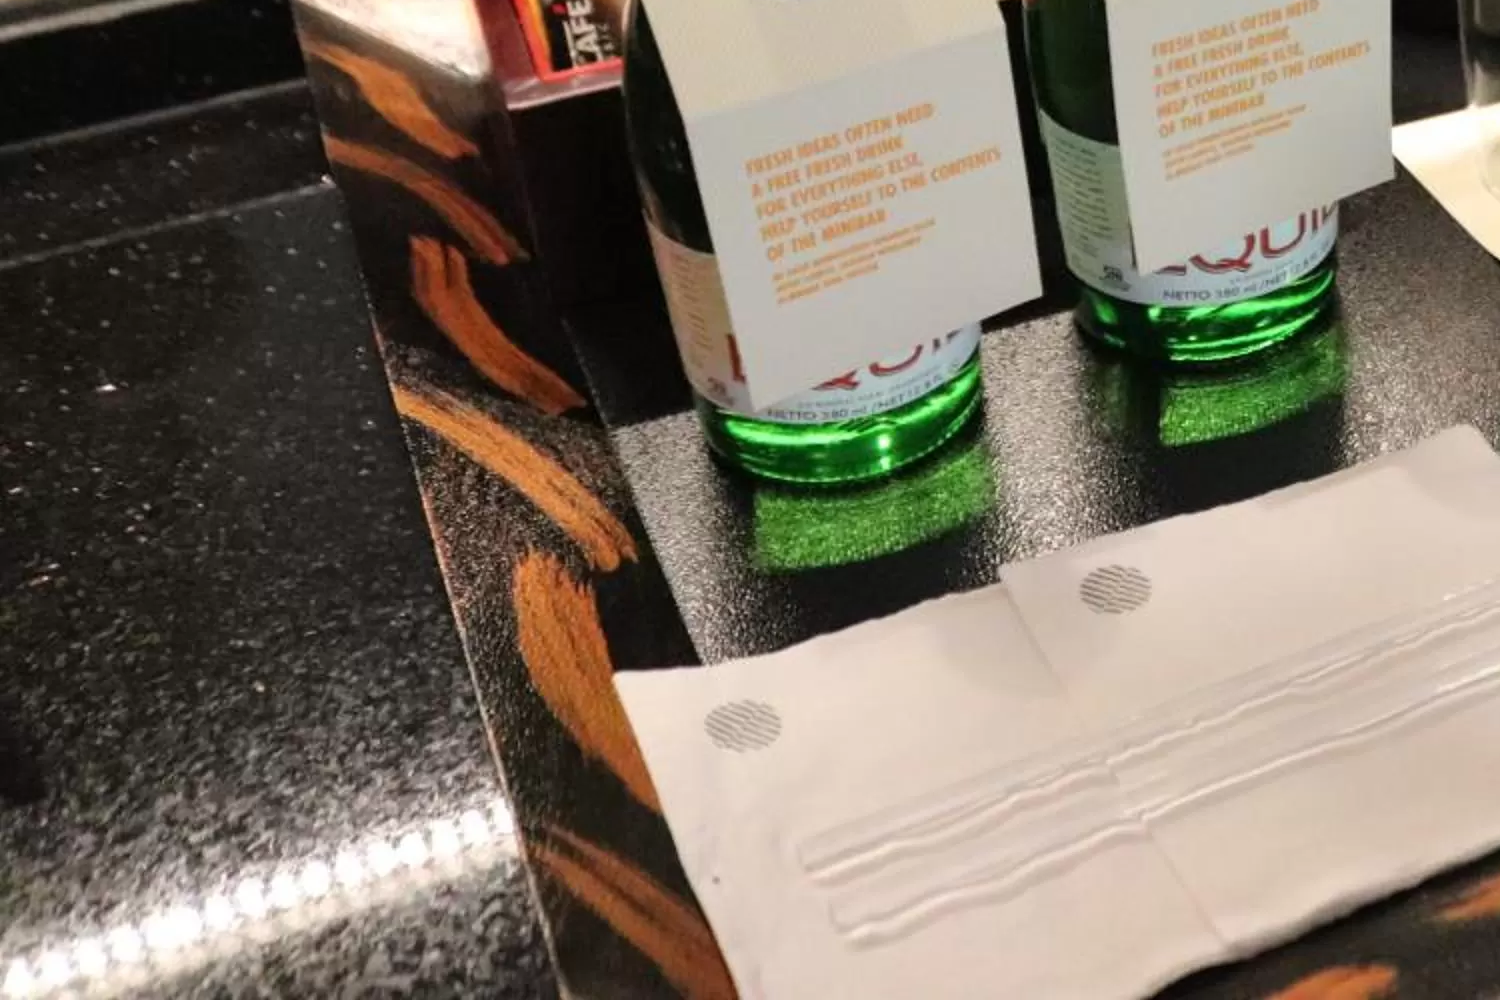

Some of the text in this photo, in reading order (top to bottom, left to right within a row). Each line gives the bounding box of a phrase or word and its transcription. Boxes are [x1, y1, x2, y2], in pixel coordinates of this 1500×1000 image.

[1153, 0, 1318, 56] FRESH IDEAS OFTEN NEED
[1154, 65, 1161, 77] A
[1169, 54, 1195, 73] FREE
[1203, 41, 1241, 62] FRESH
[1155, 80, 1180, 97] FOR
[1187, 54, 1267, 87] EVERYTHING
[1158, 41, 1369, 116] HELP YOURSELF TO THE CONTENTS
[746, 104, 933, 177] FRESH IDEAS OFTEN NEED
[1159, 122, 1174, 138] OF
[1182, 114, 1202, 130] THE
[753, 184, 761, 197] A
[768, 170, 799, 191] FREE
[807, 153, 849, 178] FRESH
[758, 199, 784, 218] FOR
[792, 168, 883, 206] EVERYTHING
[761, 148, 1000, 241] HELP YOURSELF TO THE CONTENTS
[767, 244, 782, 261] OF
[793, 233, 815, 251] THE
[1163, 287, 1212, 301] NETTO
